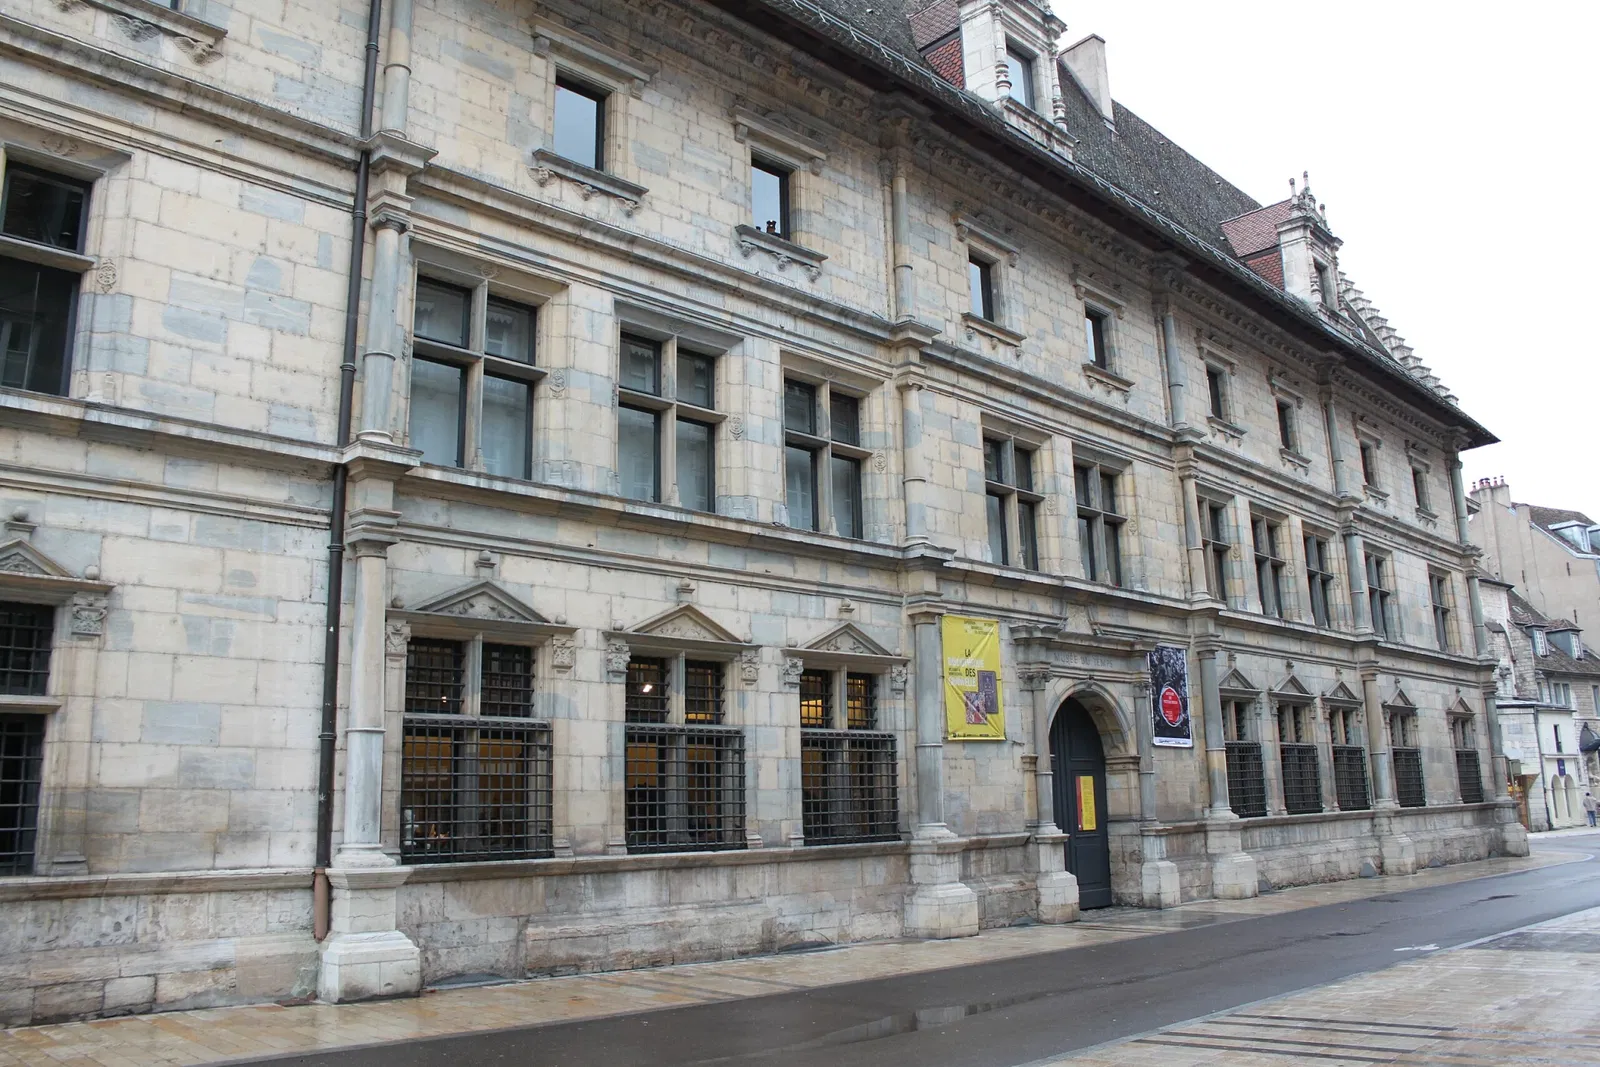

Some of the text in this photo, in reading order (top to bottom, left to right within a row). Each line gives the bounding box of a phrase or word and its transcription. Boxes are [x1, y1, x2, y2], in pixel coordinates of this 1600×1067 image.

[964, 649, 971, 658] LA
[1080, 655, 1090, 666] DU
[965, 668, 976, 677] DES
